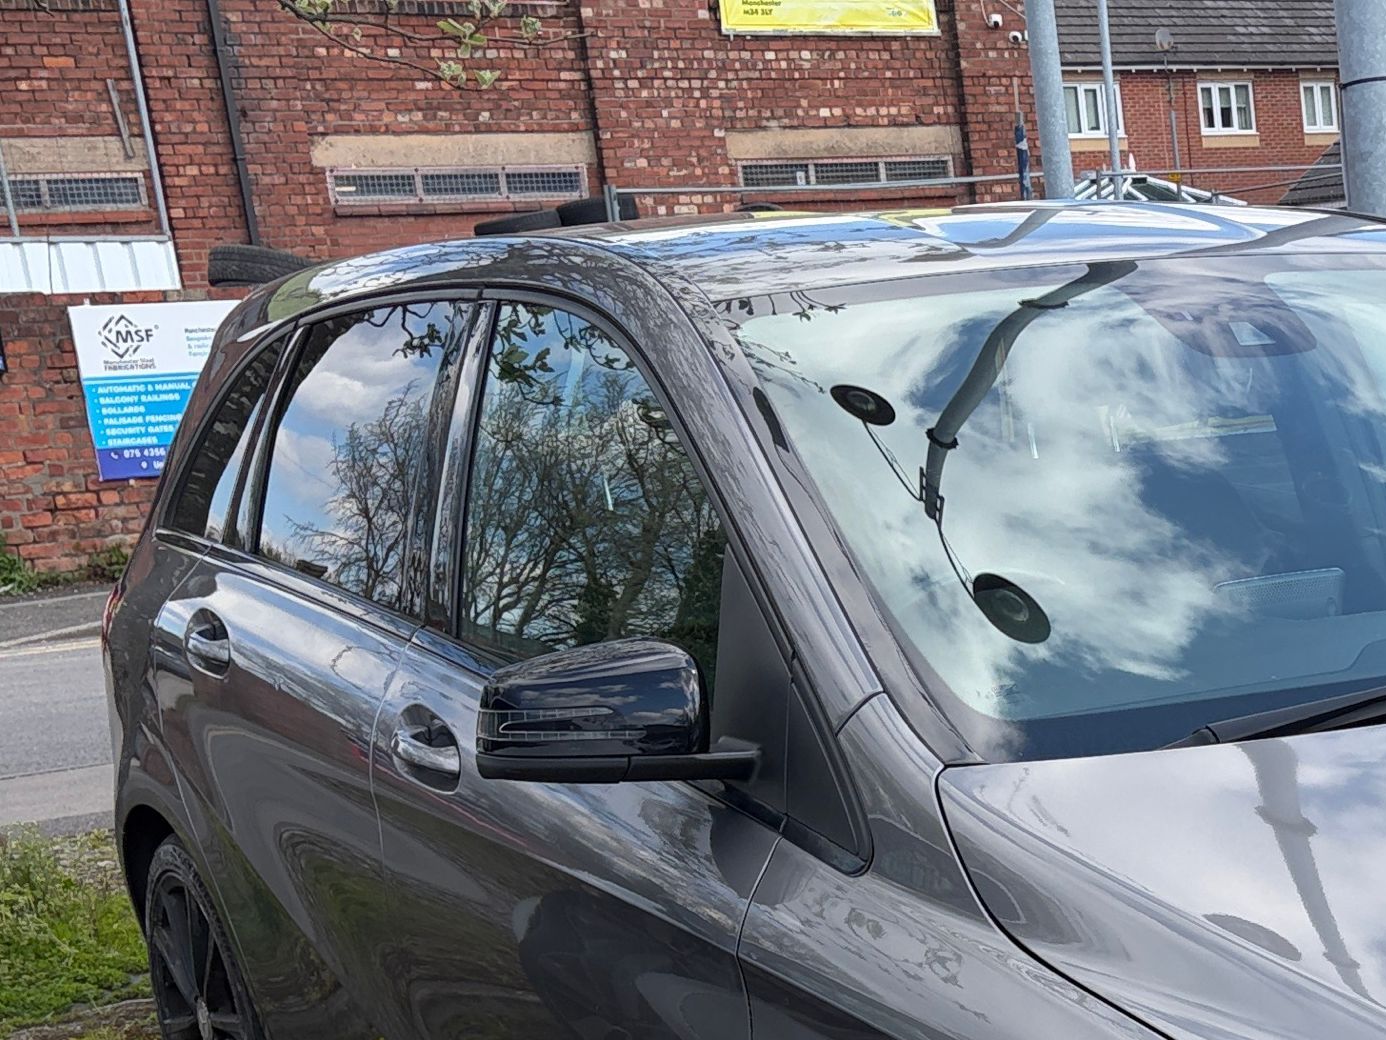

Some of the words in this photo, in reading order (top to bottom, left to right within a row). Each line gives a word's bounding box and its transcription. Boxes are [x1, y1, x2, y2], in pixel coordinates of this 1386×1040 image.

[116, 328, 153, 343] MSF
[97, 384, 146, 394] AUTOMATIC
[155, 382, 191, 391] MANUAL
[99, 395, 138, 404] BALCONY
[141, 393, 181, 402] RAILINGS
[101, 405, 146, 415] BOLLARDS
[103, 416, 144, 425] PALISADE
[105, 426, 146, 436] SECURITY
[148, 424, 174, 433] GATES
